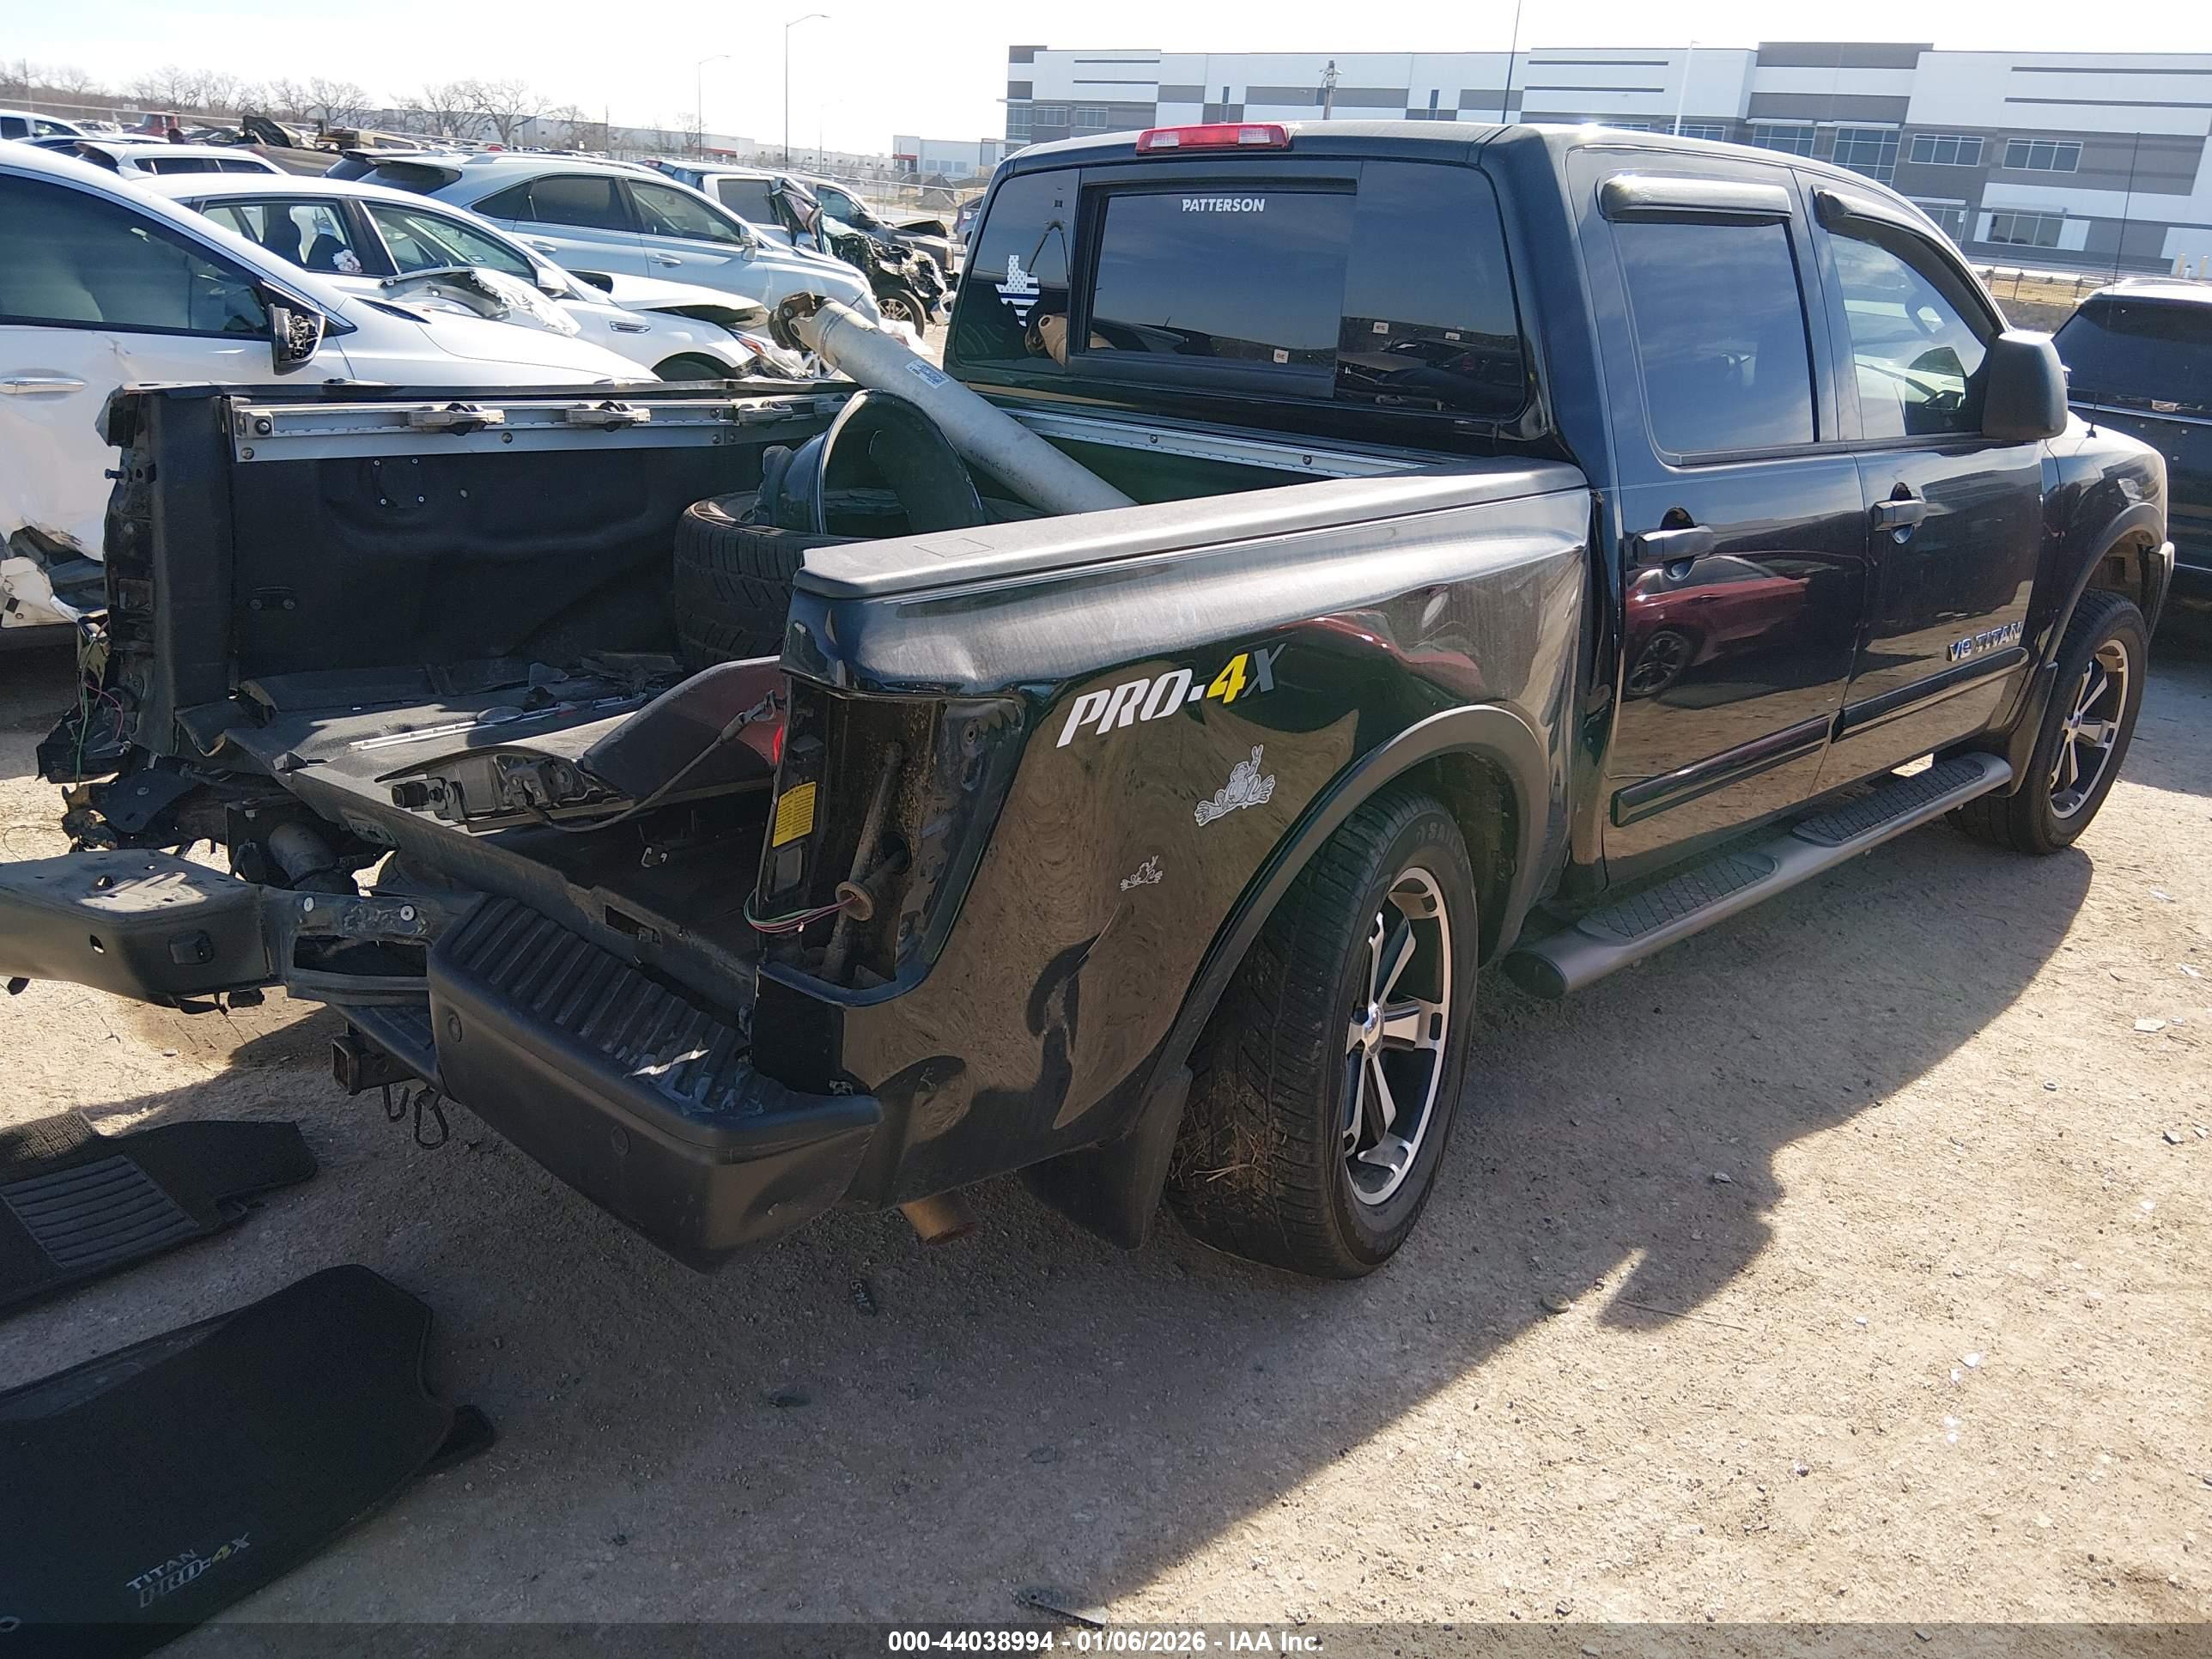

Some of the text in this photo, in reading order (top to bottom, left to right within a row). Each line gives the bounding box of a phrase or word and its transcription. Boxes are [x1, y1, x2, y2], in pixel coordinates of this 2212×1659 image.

[1182, 198, 1265, 212] PATTERSON
[1948, 622, 2022, 662] V8 TITAN
[1055, 643, 1287, 749] PRO-4X
[125, 1548, 199, 1589] TITAN
[139, 1532, 251, 1608] PRO-4X
